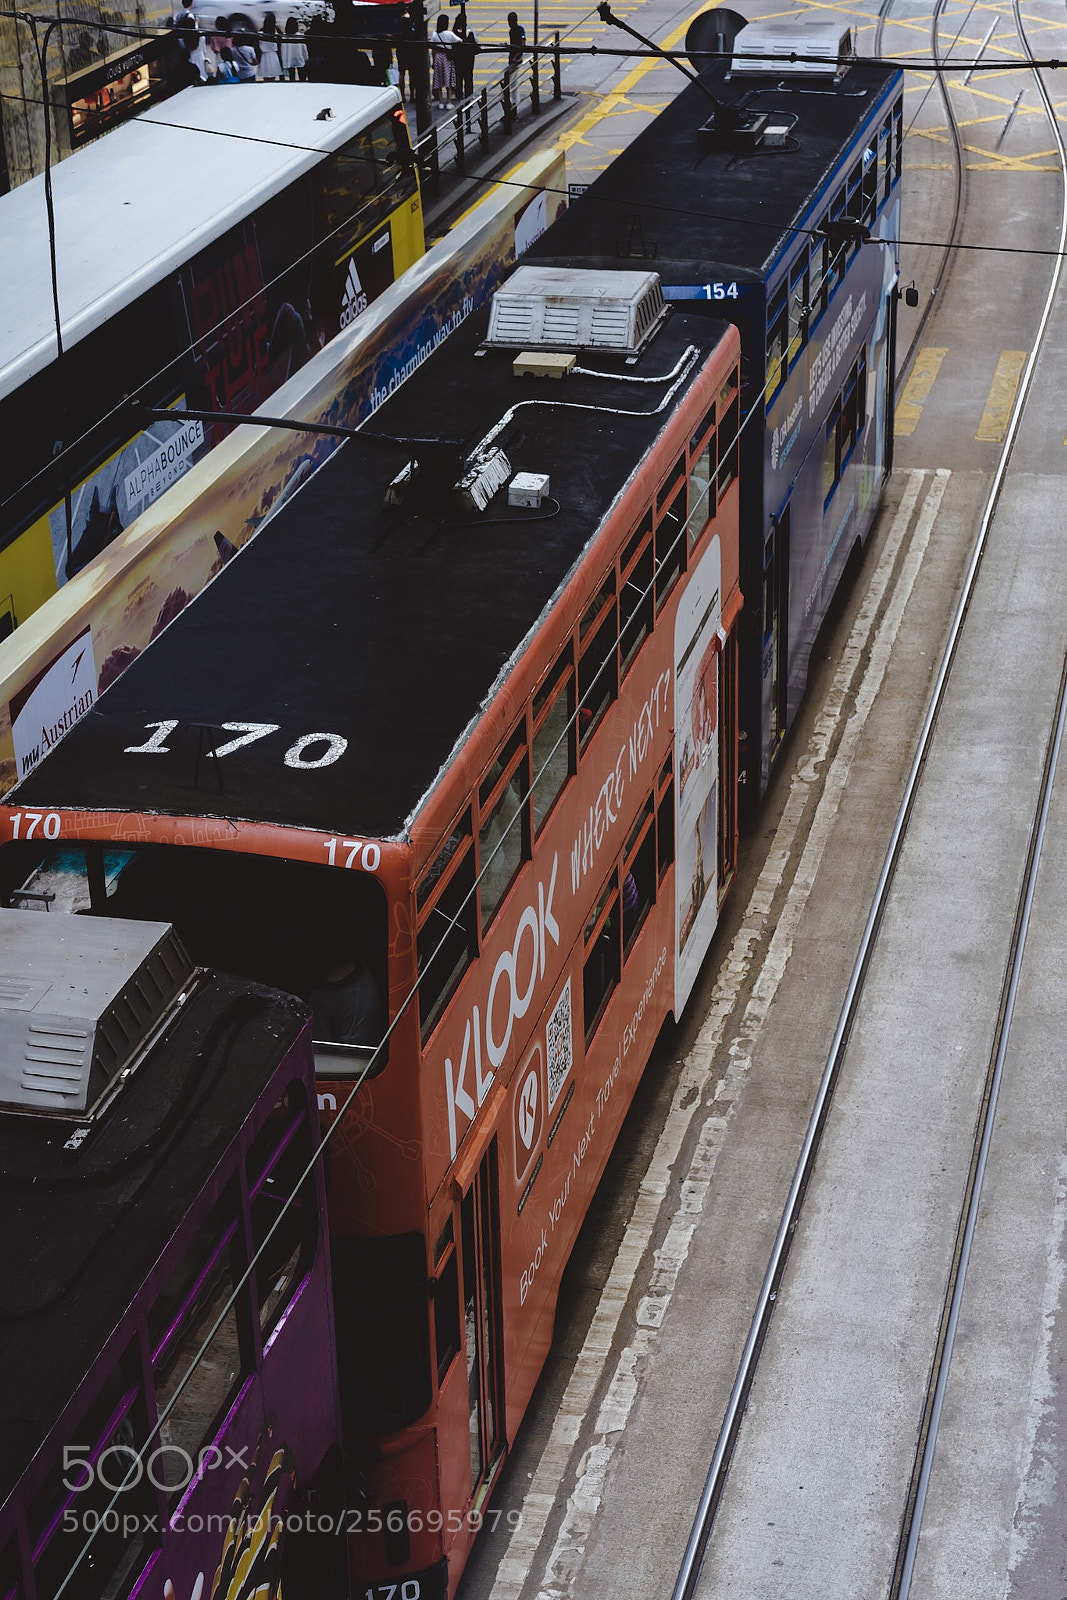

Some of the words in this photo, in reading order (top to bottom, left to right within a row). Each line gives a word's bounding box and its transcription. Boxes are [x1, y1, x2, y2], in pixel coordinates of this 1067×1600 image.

[340, 292, 368, 330] adidas
[703, 282, 739, 300] 154
[370, 386, 388, 413] the
[389, 338, 432, 394] charming
[432, 318, 451, 348] way
[452, 309, 463, 329] to
[128, 420, 202, 501] ALPHABOUNCE
[40, 688, 95, 750] Austrian
[123, 719, 349, 770] 170
[571, 744, 626, 896] WHERE
[628, 668, 671, 784] NEXT?
[9, 812, 62, 841] 170
[323, 838, 381, 872] 170
[445, 851, 560, 1162] KLOOK
[518, 1228, 549, 1307] Book
[548, 1171, 572, 1233] Your
[573, 1110, 595, 1179] Next
[595, 1051, 622, 1120] Travel
[622, 945, 668, 1057] Experience
[365, 1580, 420, 1600] 170
